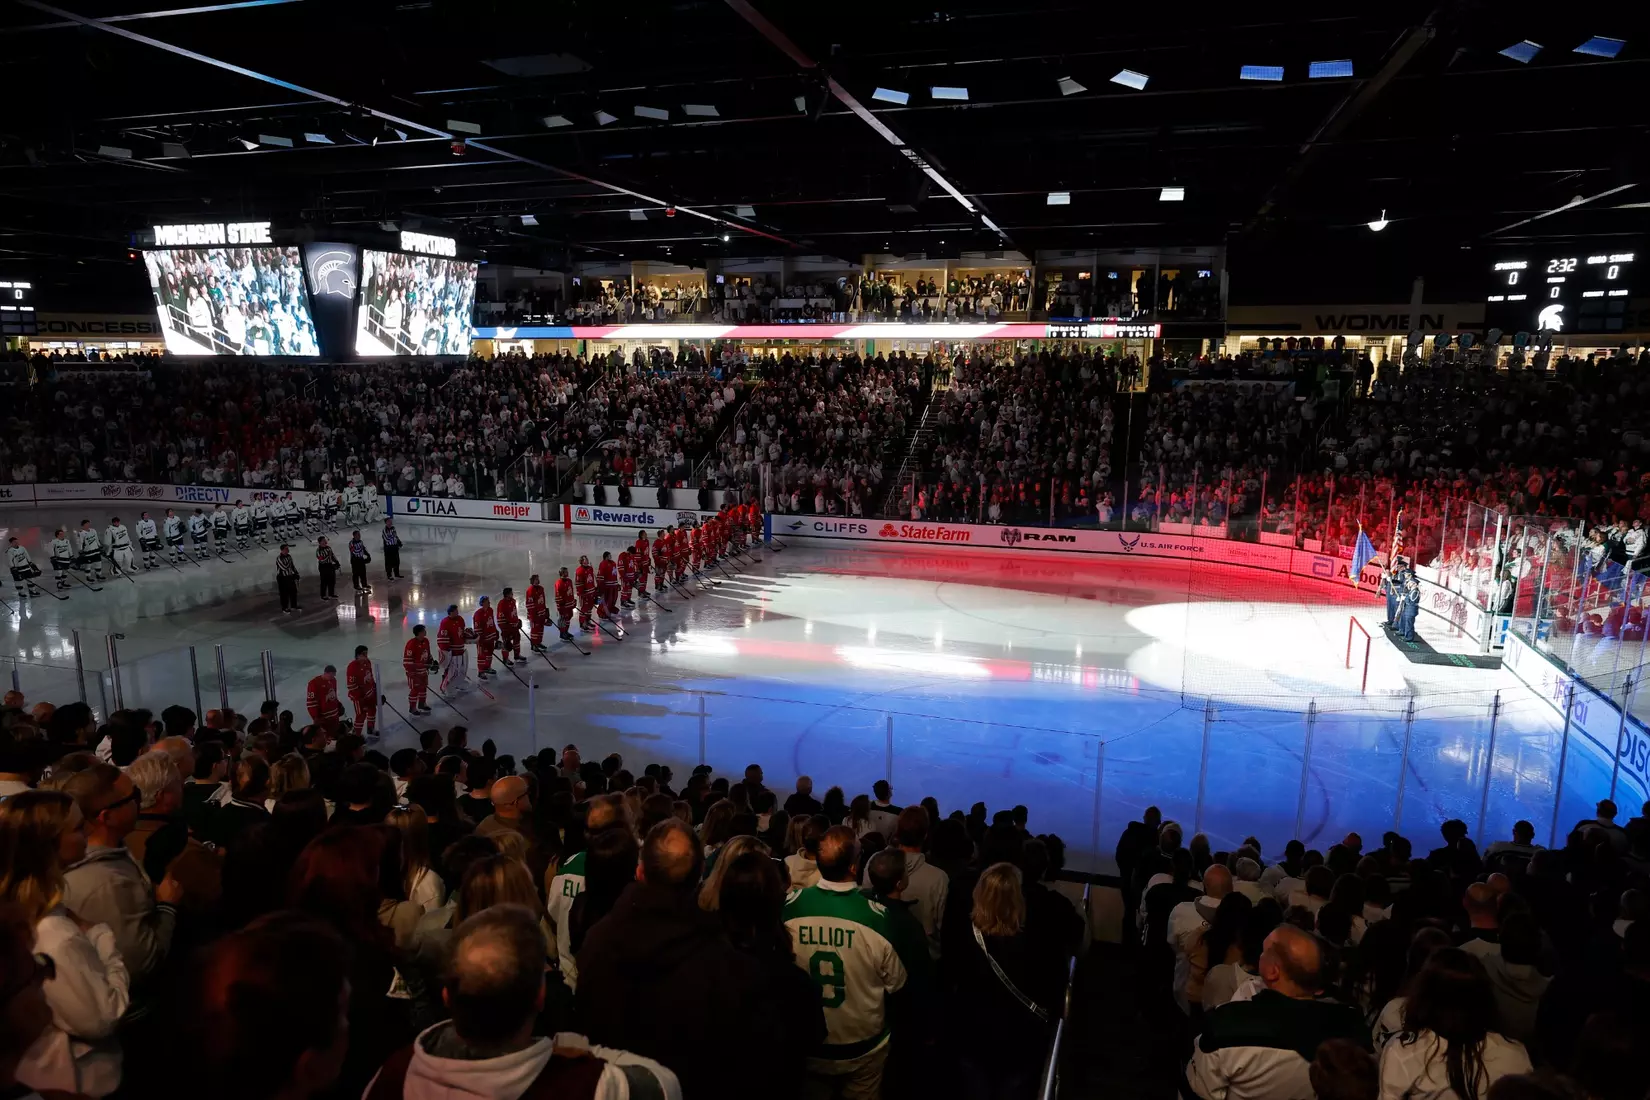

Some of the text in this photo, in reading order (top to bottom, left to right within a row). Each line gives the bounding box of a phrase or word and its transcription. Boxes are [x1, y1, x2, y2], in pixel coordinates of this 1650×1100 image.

[153, 222, 272, 246] MICHIGAN STATE
[400, 231, 456, 257] SPARTANS
[1547, 258, 1578, 273] 2:32
[1608, 265, 1618, 280] 0
[1508, 272, 1518, 285] 0
[15, 289, 22, 300] 0
[1550, 286, 1560, 298] 0
[175, 487, 230, 502] DIRECTV
[422, 500, 458, 515] TIAA
[493, 503, 530, 518] meijer
[593, 509, 654, 524] Rewards
[814, 522, 868, 534] CLIFFS
[1024, 533, 1076, 542] RAM
[799, 926, 855, 948] ELLIOT
